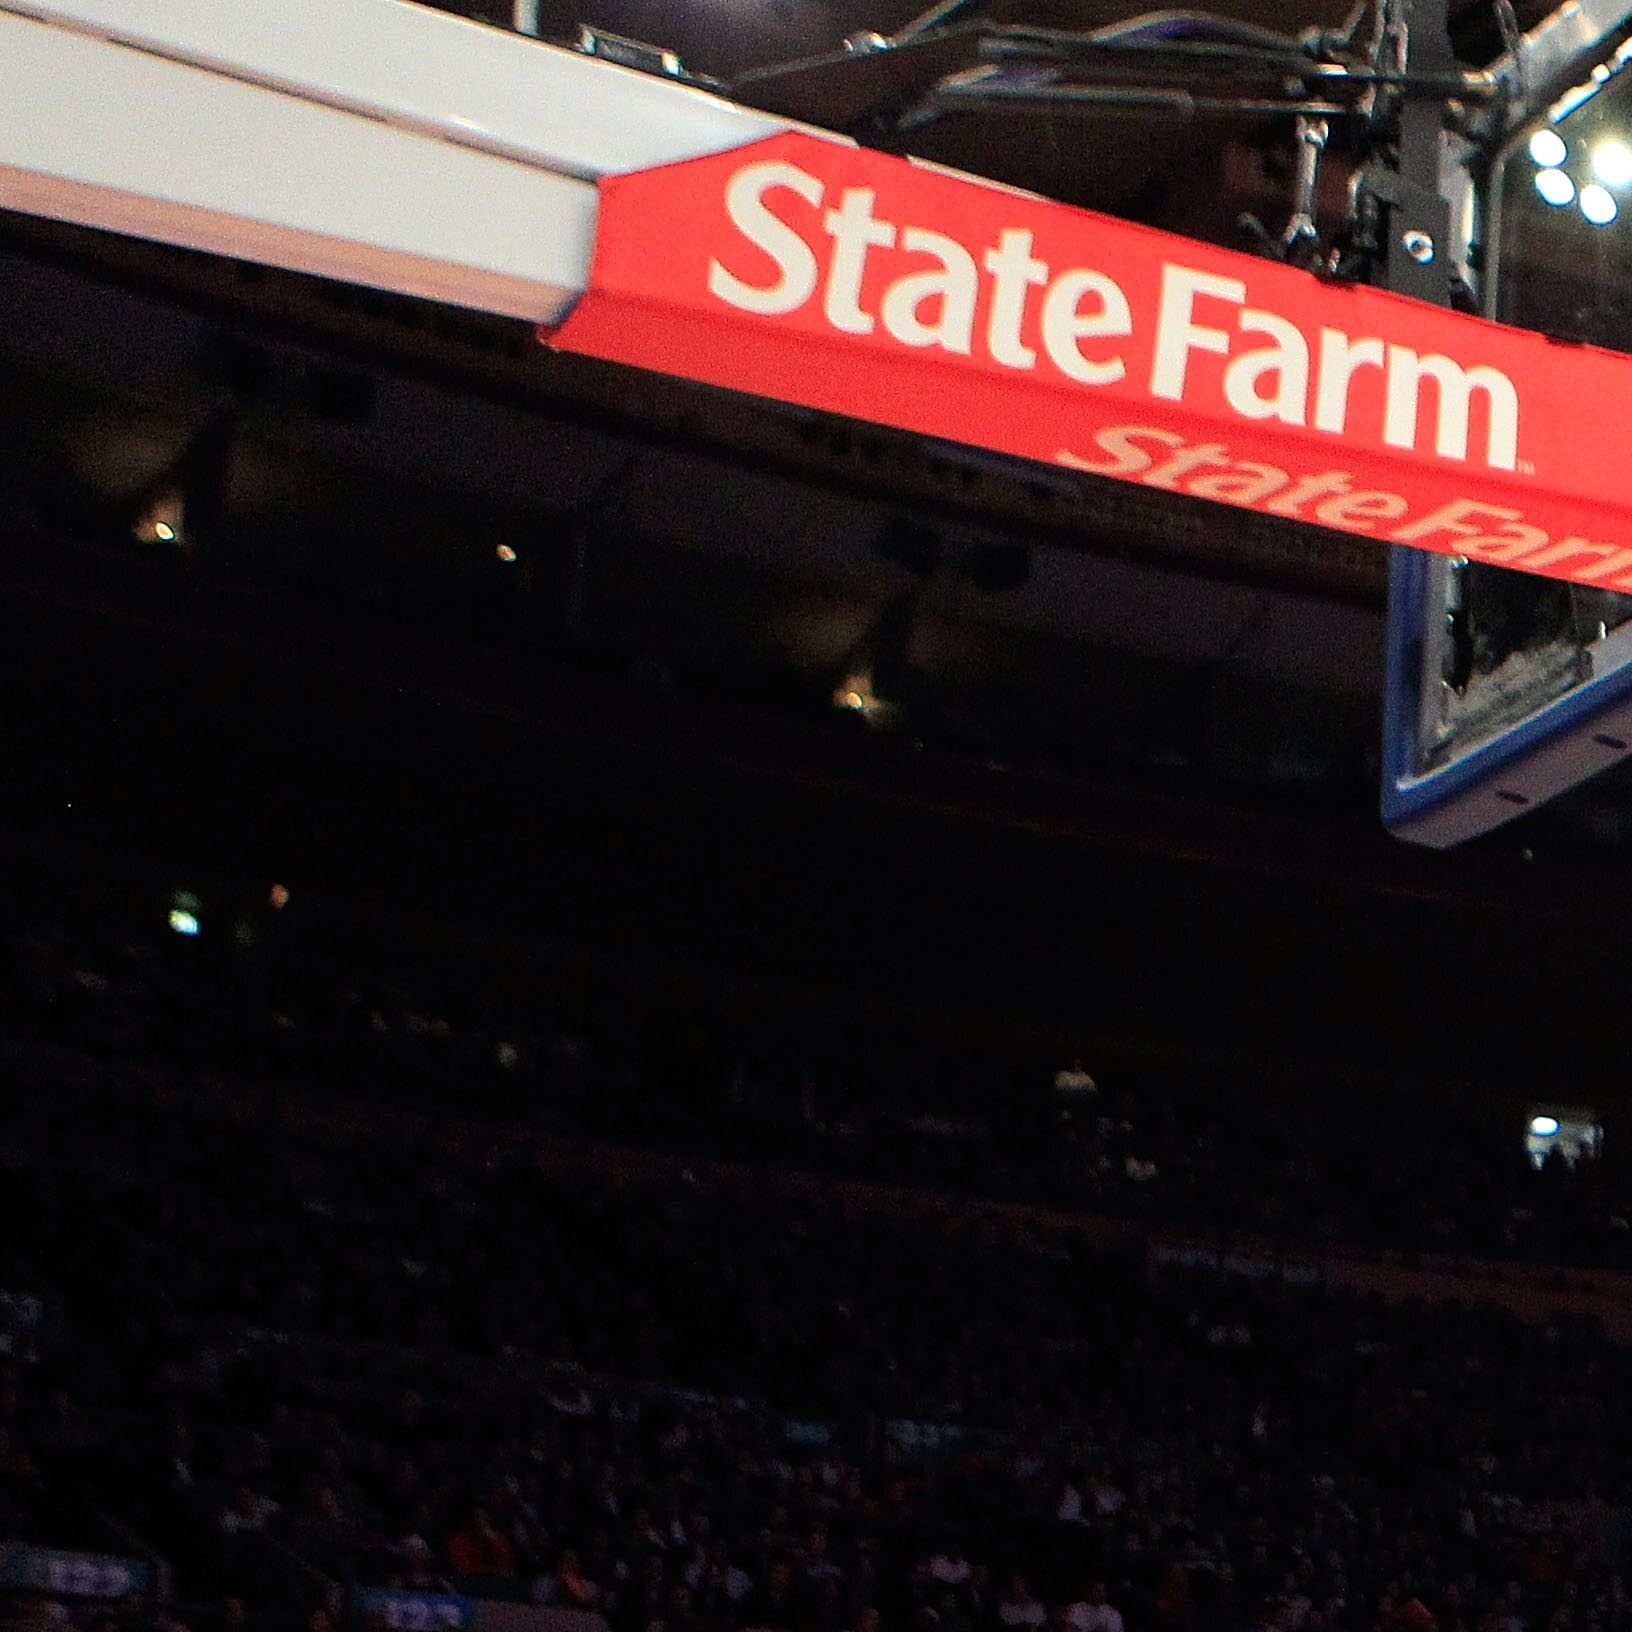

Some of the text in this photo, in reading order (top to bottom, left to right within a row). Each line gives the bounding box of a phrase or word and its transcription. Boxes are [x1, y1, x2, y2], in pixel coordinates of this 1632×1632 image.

[707, 157, 1520, 473] State Farm
[1056, 422, 1410, 532] State
